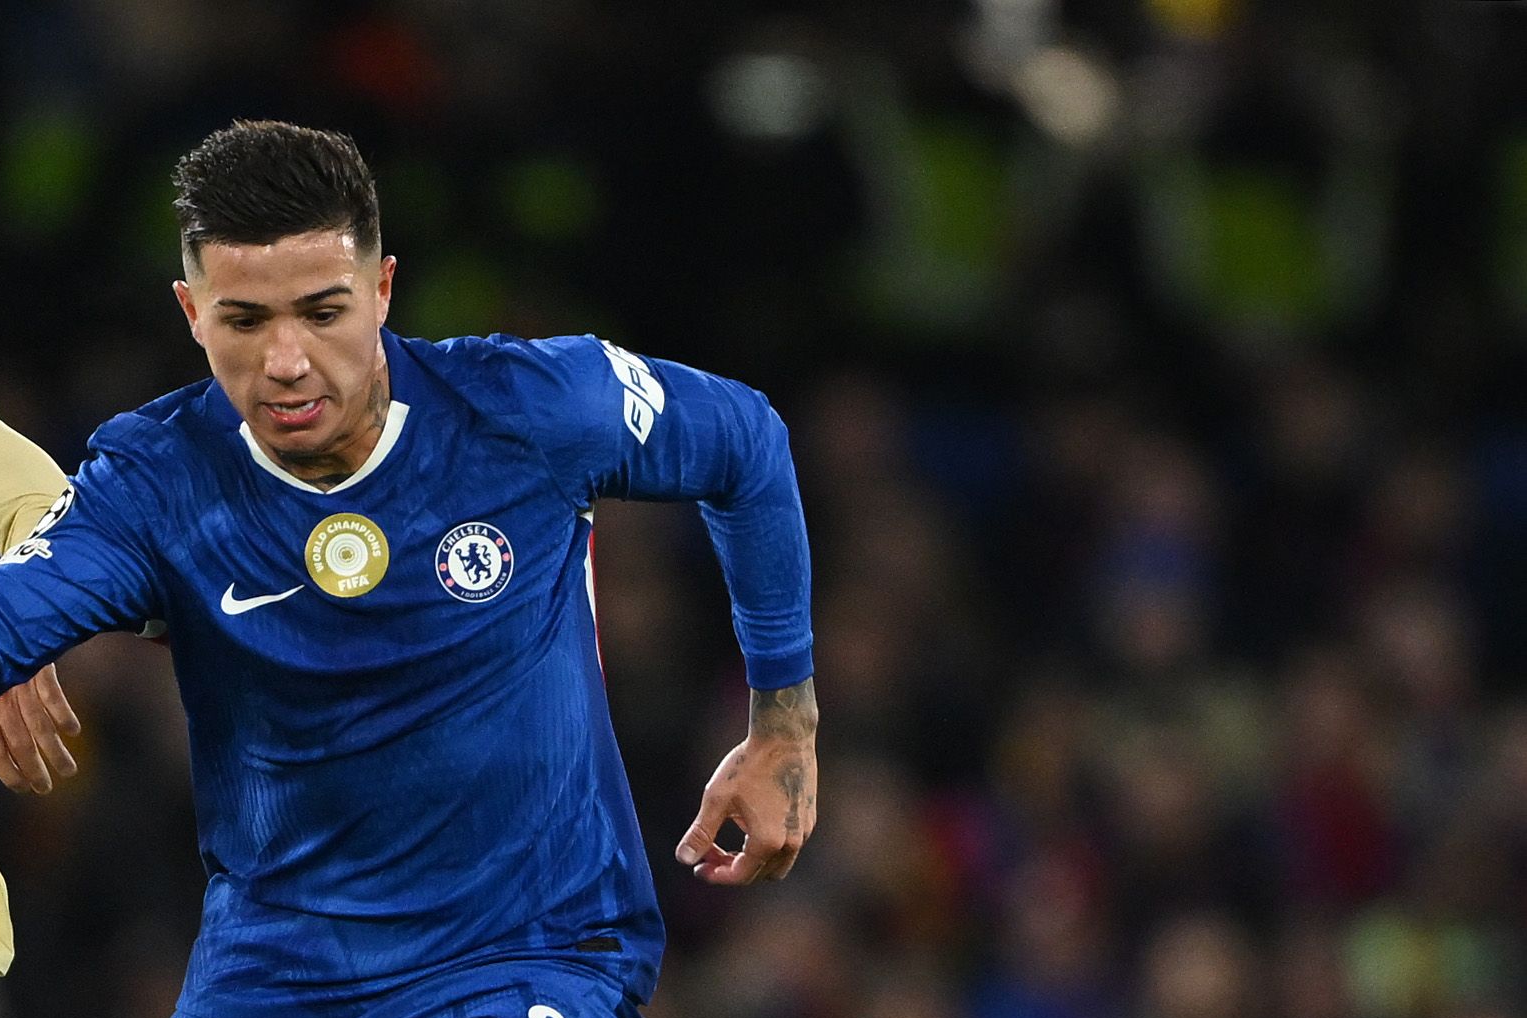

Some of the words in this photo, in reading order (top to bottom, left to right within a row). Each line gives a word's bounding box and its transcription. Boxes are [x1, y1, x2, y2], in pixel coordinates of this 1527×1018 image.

[312, 532, 327, 573] WORLD
[326, 520, 381, 557] CHAMPIONS
[441, 525, 488, 553] CHELSEA
[338, 575, 370, 592] FIFA
